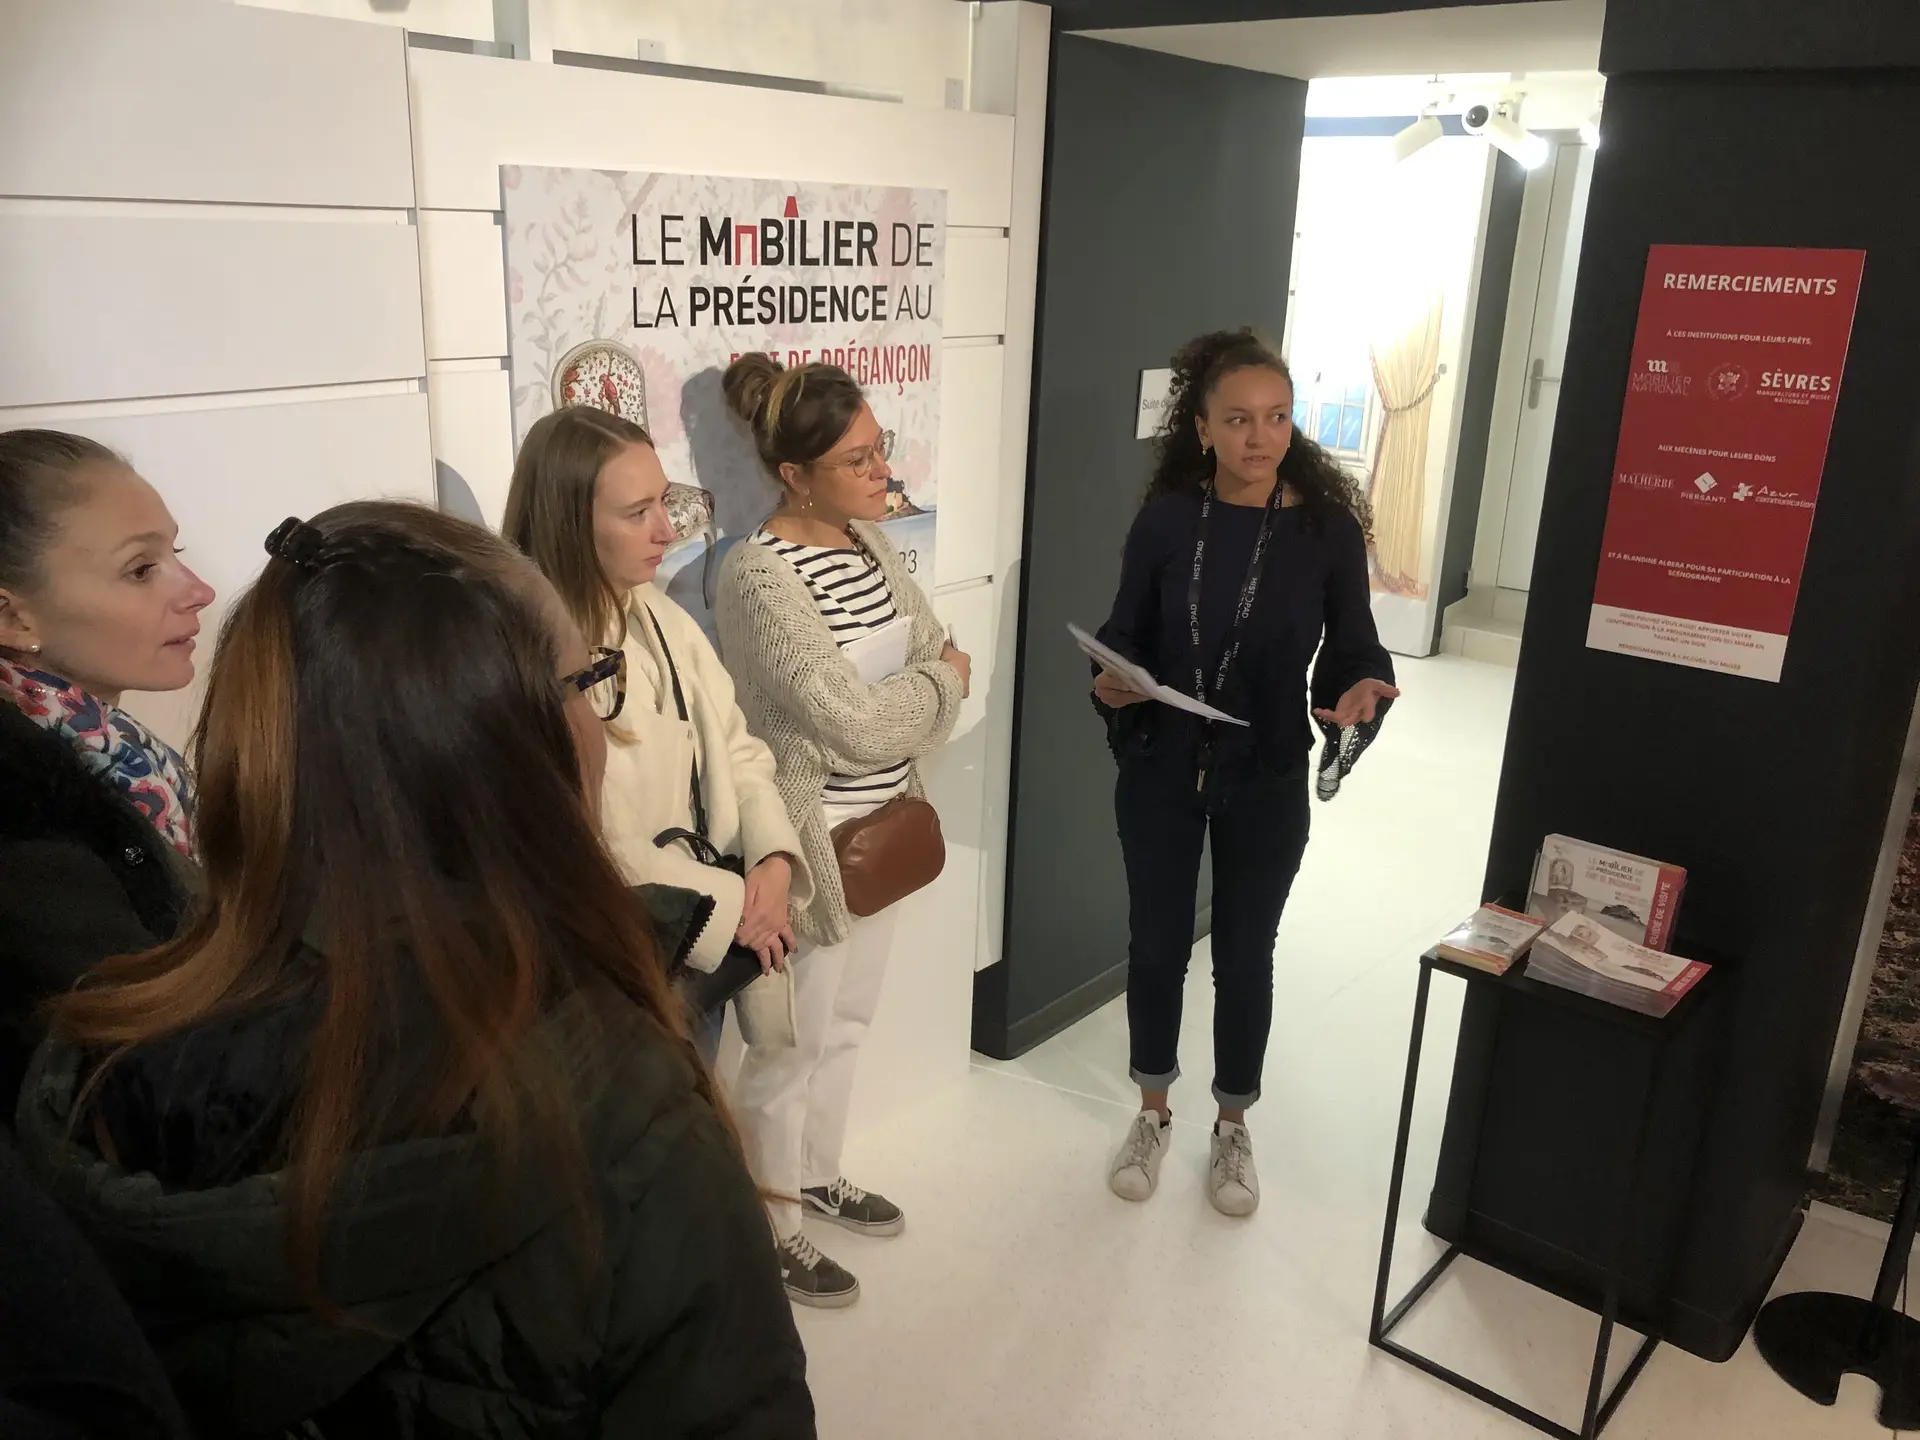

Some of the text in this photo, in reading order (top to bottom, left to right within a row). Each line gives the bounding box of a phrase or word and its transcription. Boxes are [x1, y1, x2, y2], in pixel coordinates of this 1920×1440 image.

[631, 213, 685, 266] LE
[891, 222, 935, 267] DE
[1663, 272, 1838, 295] REMERCIEMENTS
[632, 274, 932, 328] LA PRÉSIDENCE AU
[1673, 330, 1686, 338] CES
[1687, 331, 1738, 341] INSTITUTIONS
[1739, 334, 1761, 342] POUR
[1762, 335, 1786, 344] LEURS
[1632, 372, 1692, 386] MOBILIER
[1760, 368, 1832, 392] SÈVRES
[1631, 382, 1689, 396] NATIONAL
[1801, 392, 1809, 400] ET
[1657, 444, 1777, 463] AUX MÉCÈNES POUR LEURS DONS
[1618, 473, 1675, 489] MALHERBE
[1680, 491, 1727, 504] PIERSANTI
[1757, 485, 1799, 498] Azur
[1607, 551, 1616, 559] ET
[1622, 553, 1657, 565] BLANDINE
[1685, 563, 1706, 572] POUR
[1706, 566, 1717, 574] SA
[1717, 567, 1773, 582] PARTICIPATION
[1780, 576, 1792, 585] LA
[1649, 881, 1671, 945] GUIDE DE VISITE
